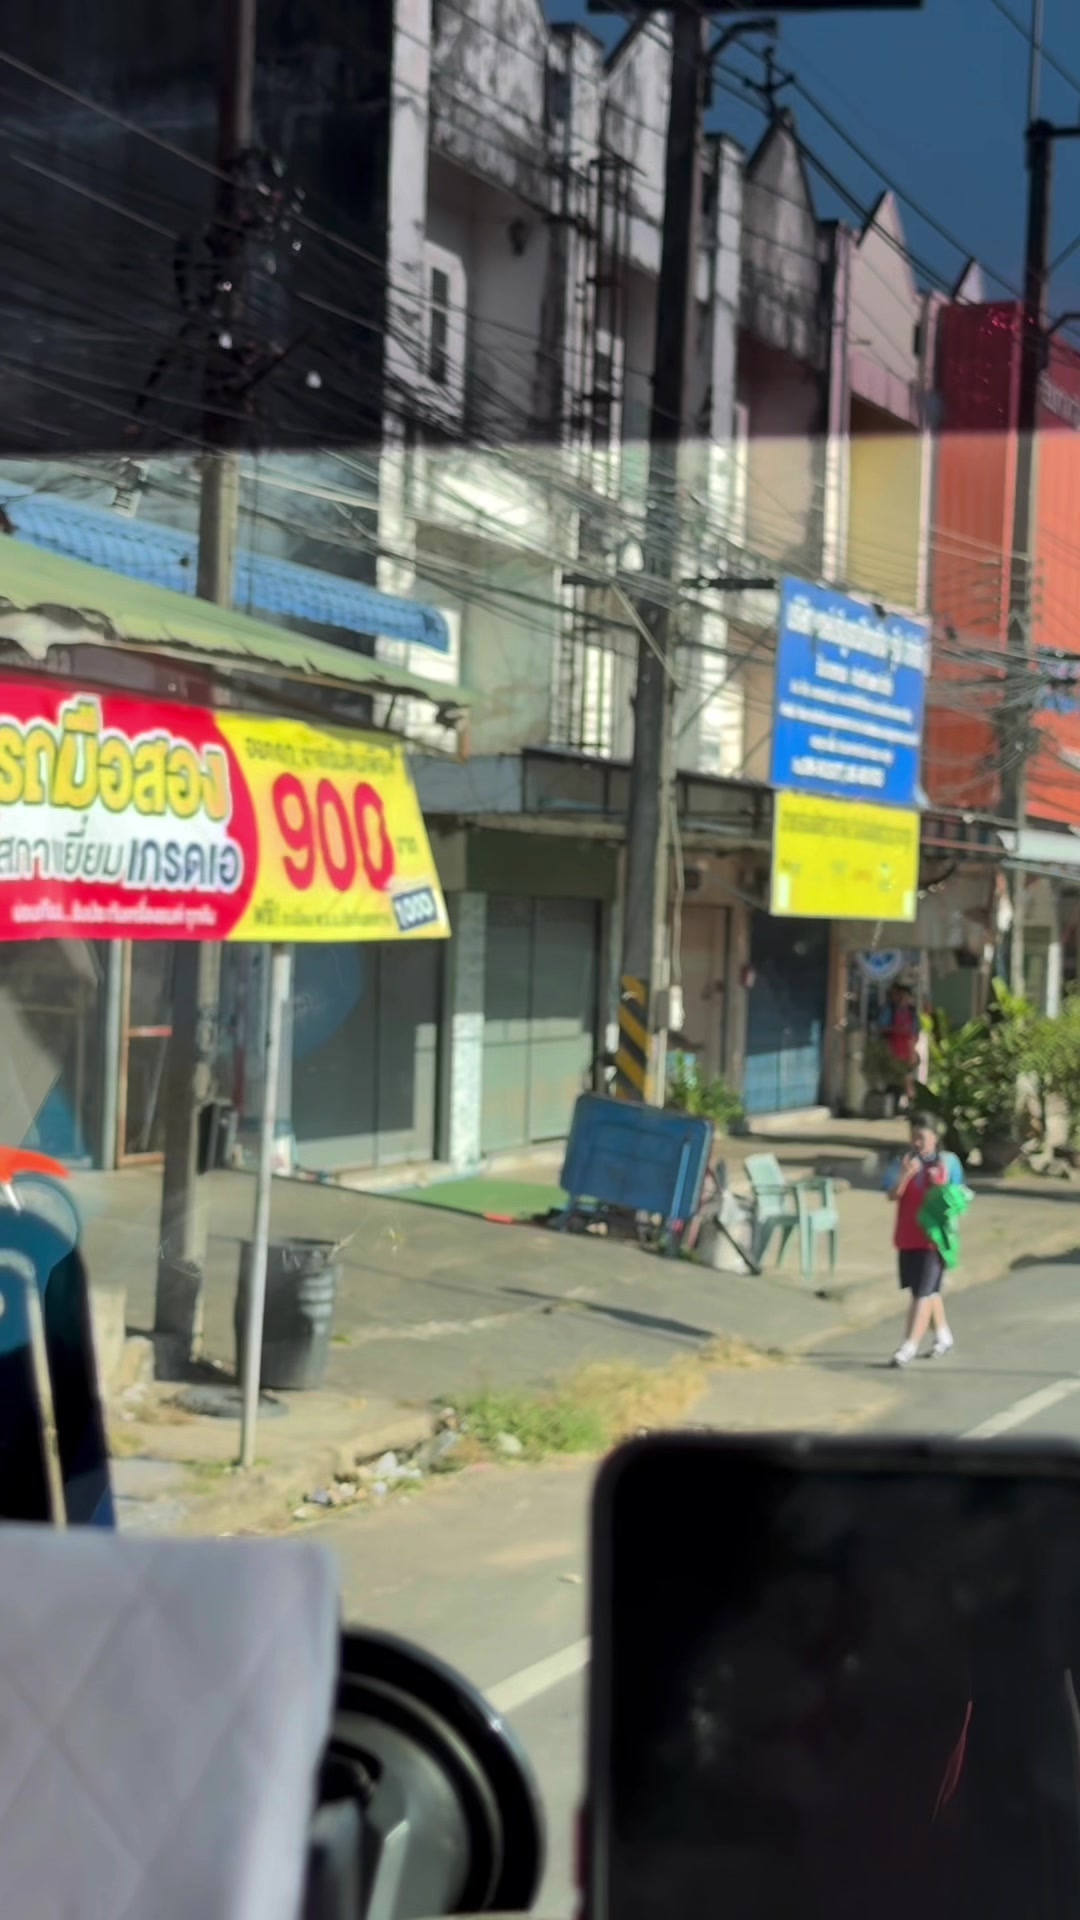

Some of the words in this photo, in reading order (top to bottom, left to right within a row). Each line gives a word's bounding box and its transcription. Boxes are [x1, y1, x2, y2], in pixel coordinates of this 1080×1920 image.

[0, 698, 231, 822] รถมือสอง
[0, 815, 125, 878] สภายี่ยม
[127, 838, 240, 886] เกรดเอ
[271, 772, 395, 892] 900
